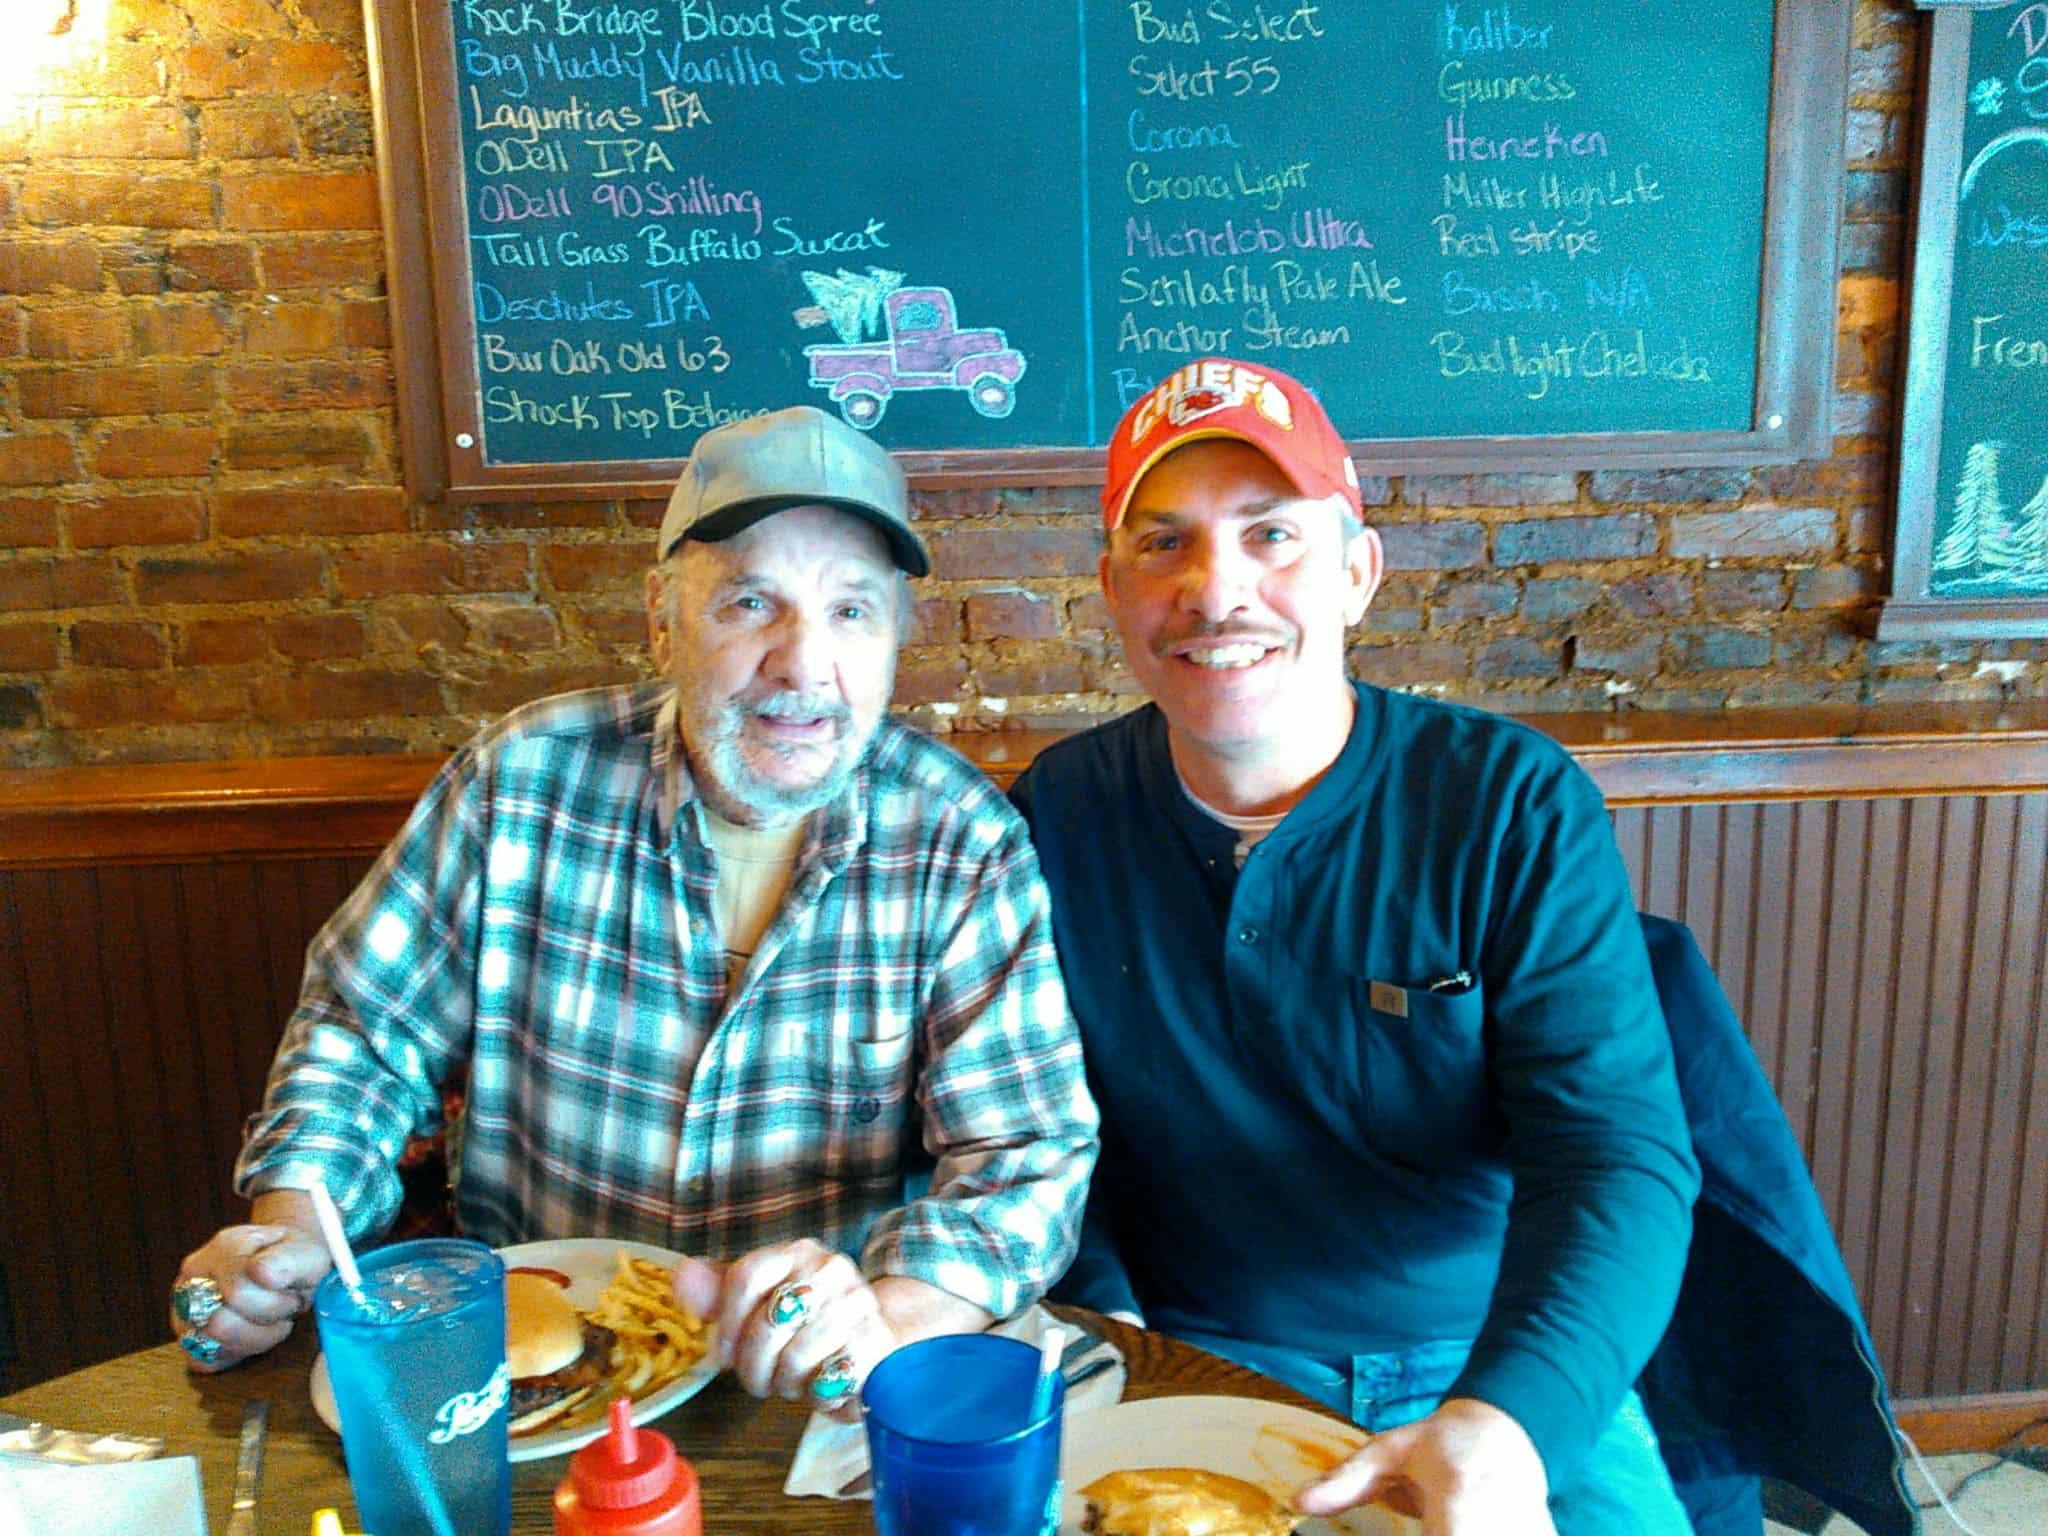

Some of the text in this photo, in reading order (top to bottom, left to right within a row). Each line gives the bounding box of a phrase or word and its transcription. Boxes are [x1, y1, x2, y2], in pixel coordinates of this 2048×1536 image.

[464, 0, 882, 56] Rock Bridge Blood Spree
[1129, 0, 1325, 45] Bud Select
[459, 39, 904, 107] Big Muddy Vanilla Stout
[1128, 54, 1281, 100] Select 55
[650, 85, 712, 132] IPA
[1127, 108, 1241, 152] Corona
[584, 138, 676, 178] IPA
[592, 183, 643, 218] 90
[645, 176, 762, 235] Shilling
[1126, 160, 1311, 211] Corona Light
[1443, 171, 1527, 209] Miller
[470, 217, 890, 267] Tall Grass Buffalo Sweat
[1125, 207, 1374, 258] Michelob Ultra
[1431, 213, 1499, 257] Red
[474, 277, 711, 328] Deschutes IPA
[1119, 259, 1408, 310] Schlafly Pale Ale
[1116, 306, 1350, 353] Anchor Steam
[482, 334, 730, 376] Bur Oak Old 63
[1430, 330, 1504, 376] Bud
[1580, 329, 1711, 382] Chelda
[486, 386, 599, 431] Shock
[598, 391, 660, 438] Top
